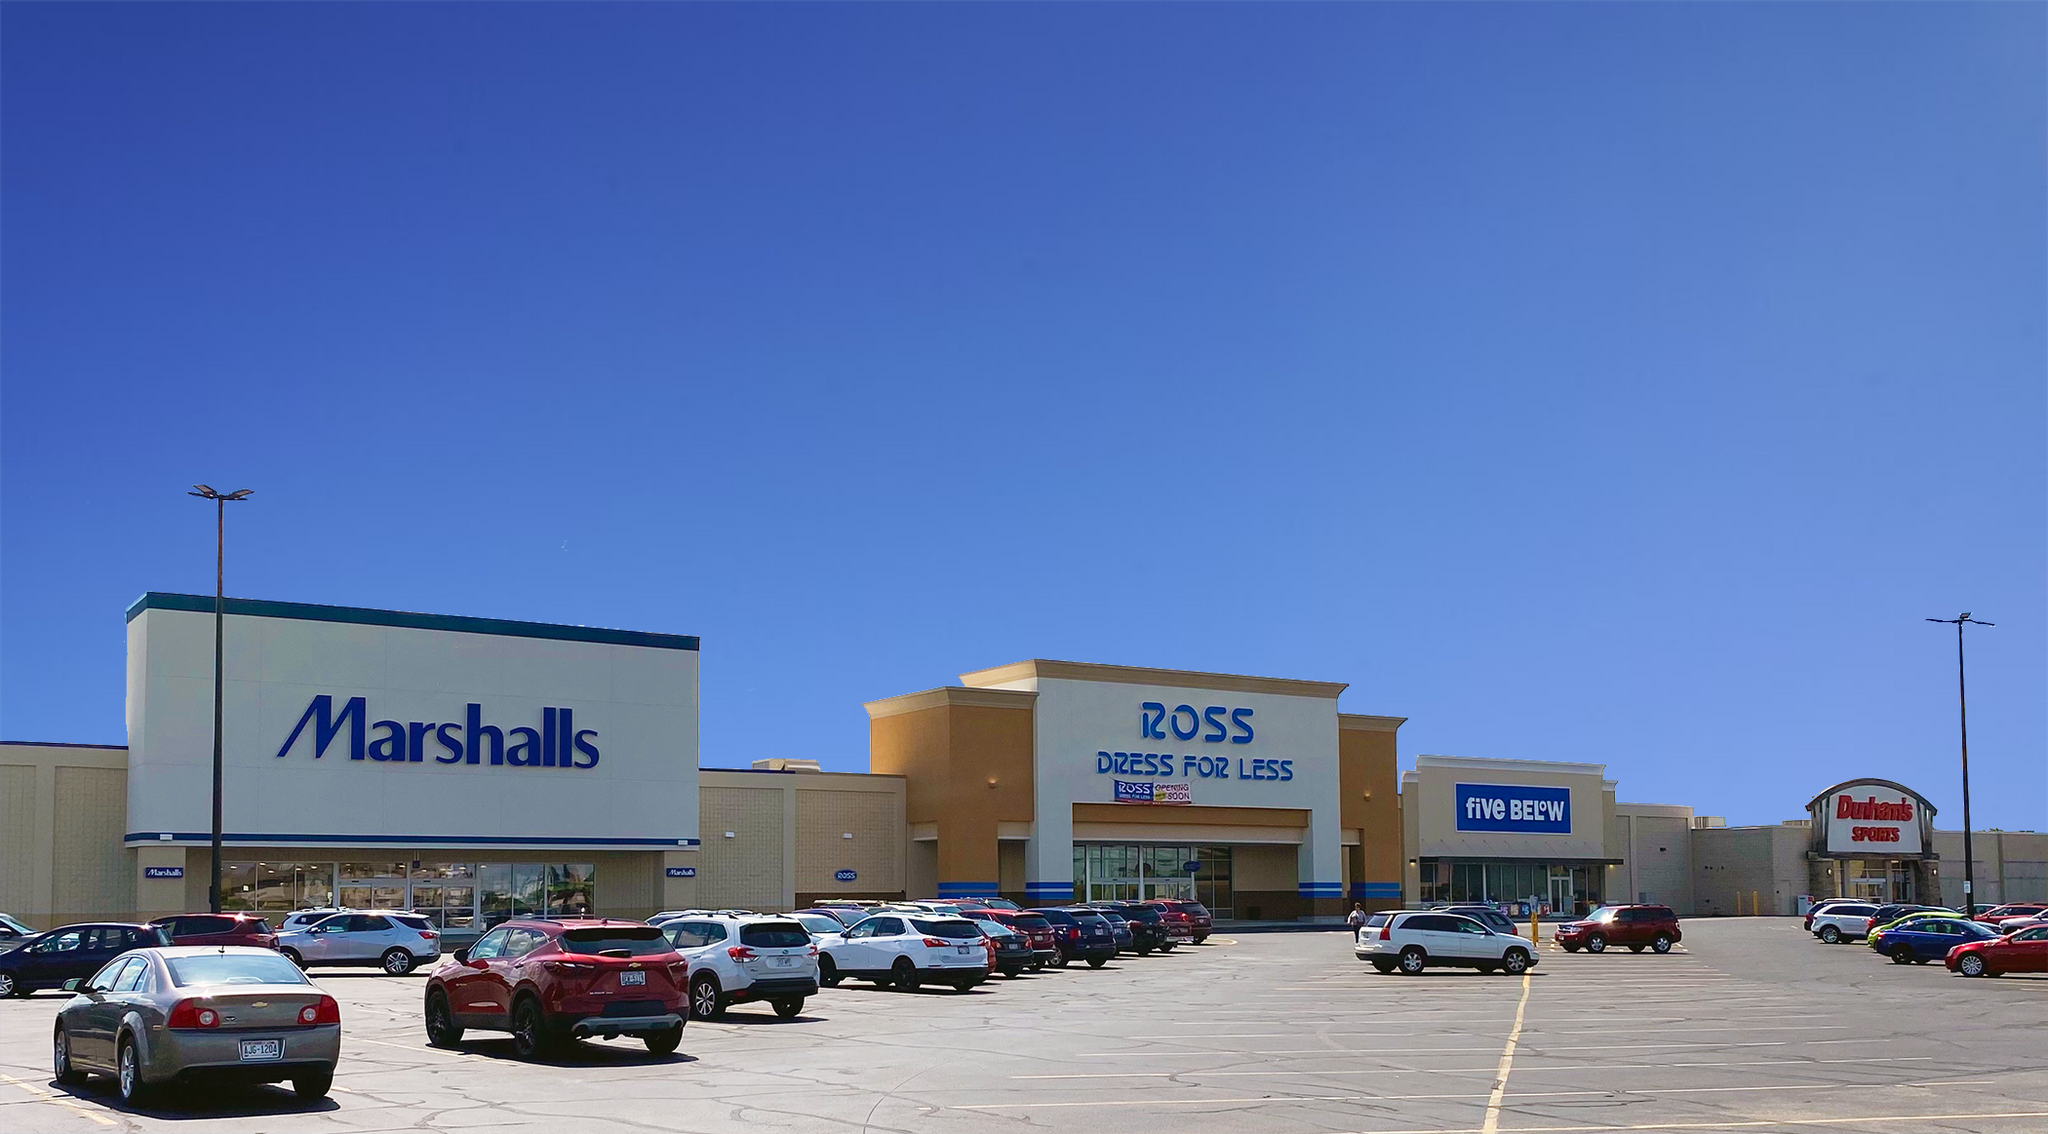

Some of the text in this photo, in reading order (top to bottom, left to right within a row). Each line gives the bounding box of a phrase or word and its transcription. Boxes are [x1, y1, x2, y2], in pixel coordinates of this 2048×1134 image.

[276, 694, 600, 769] Marshalls
[1141, 701, 1254, 744] ROSS
[1097, 751, 1293, 781] DRESS FOR LESS
[1118, 782, 1151, 794] ROSS
[1167, 792, 1190, 800] SOON
[1836, 795, 1913, 821] Dunham's
[1851, 826, 1900, 842] SPORTS
